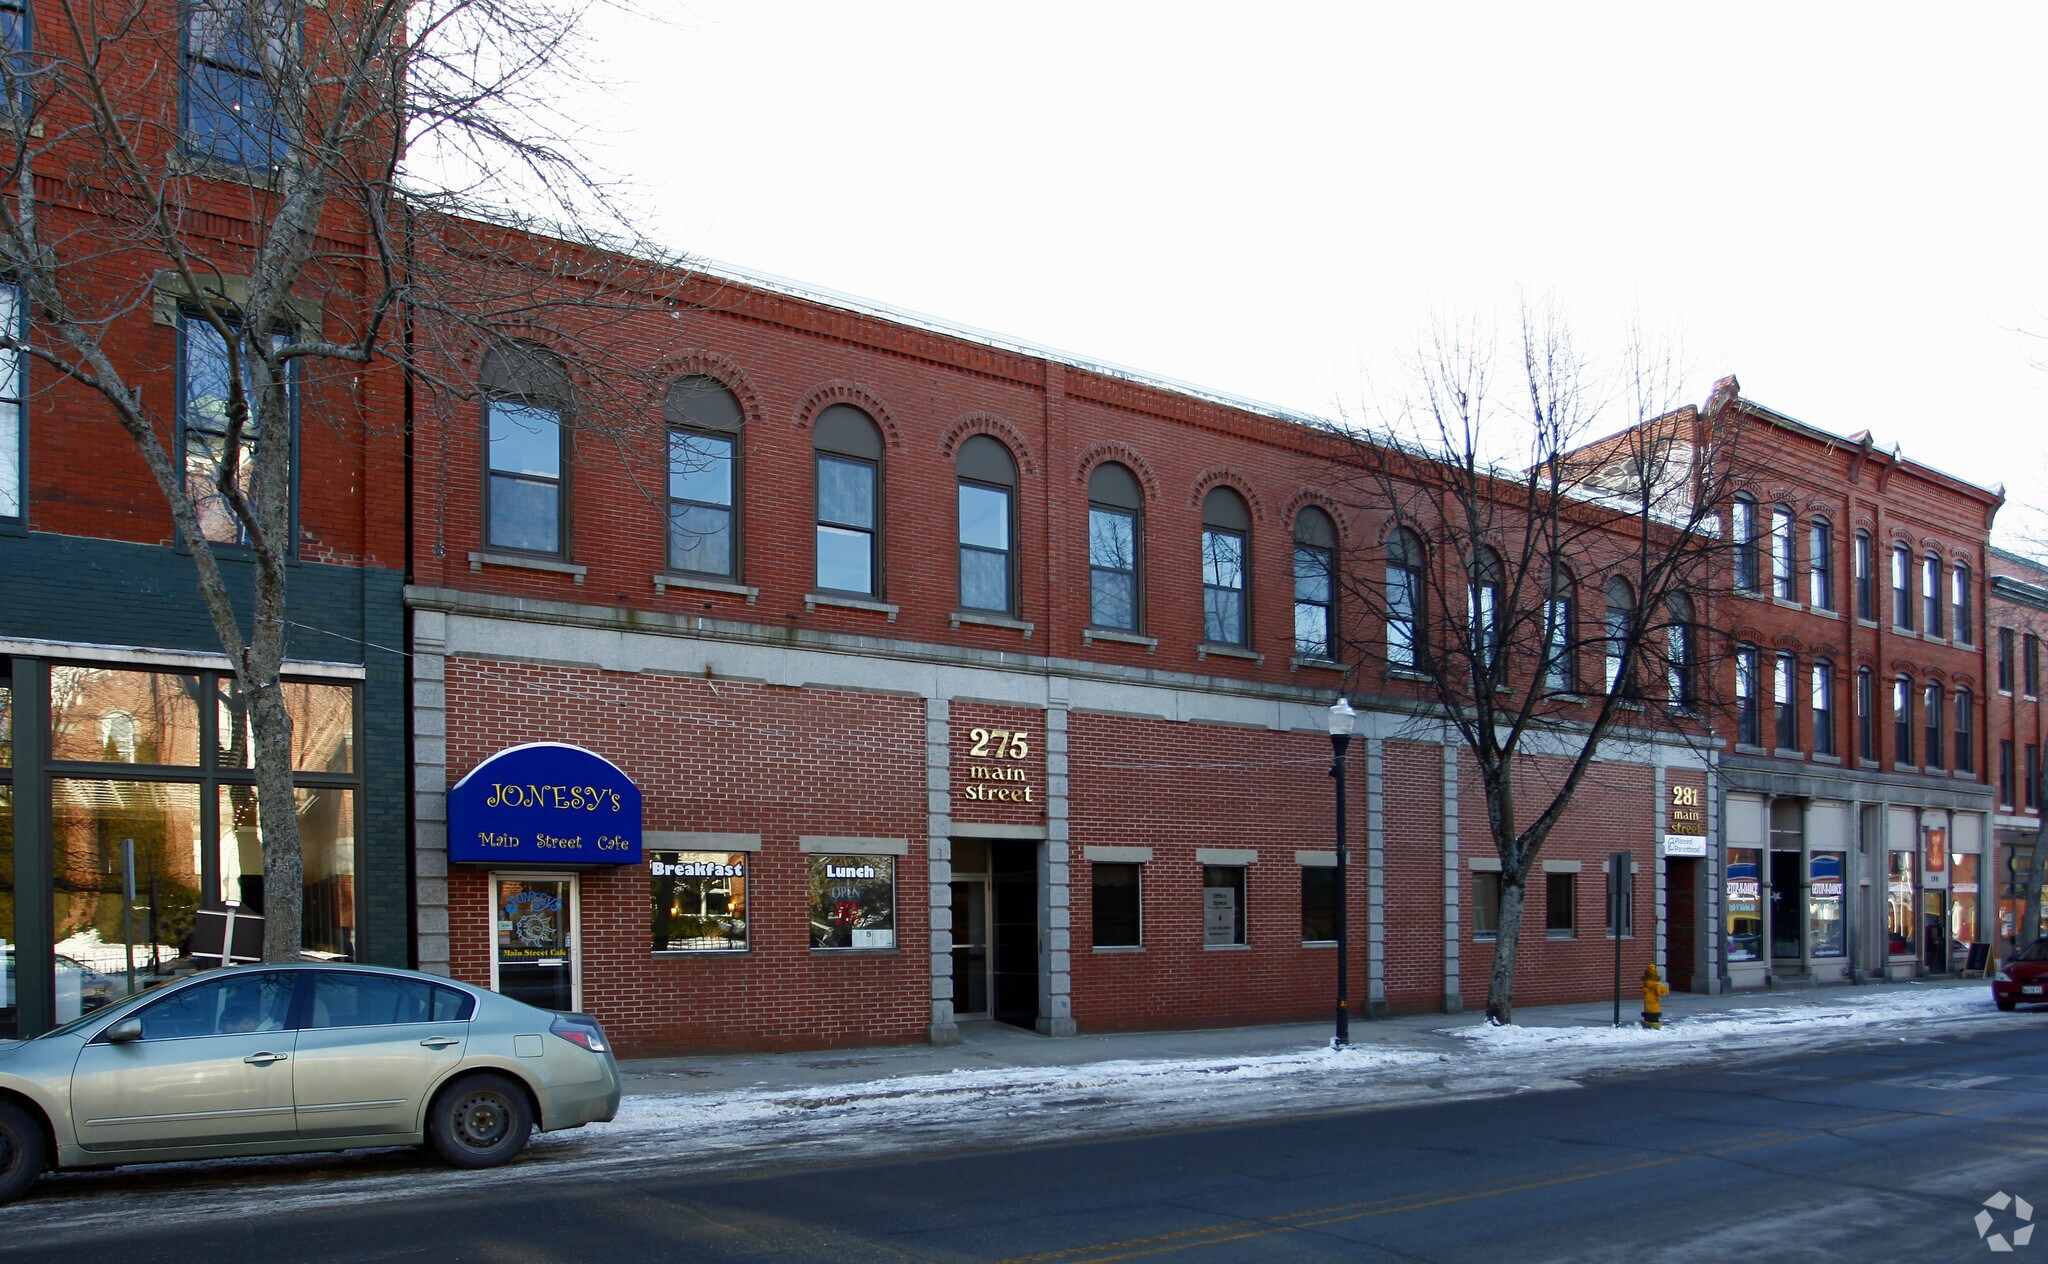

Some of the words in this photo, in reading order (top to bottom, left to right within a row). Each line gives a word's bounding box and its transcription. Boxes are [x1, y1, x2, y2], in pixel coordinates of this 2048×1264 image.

[969, 728, 1028, 760] 275
[970, 764, 1026, 781] main
[965, 783, 1034, 803] street
[1672, 785, 1698, 806] 281
[1673, 809, 1699, 820] main
[1671, 823, 1701, 834] street
[478, 832, 520, 848] Main
[536, 833, 583, 849] Street
[597, 835, 629, 851] Cafe
[1674, 837, 1693, 845] Planned
[651, 861, 743, 877] Breakfast
[826, 864, 875, 879] Lunch
[832, 886, 862, 899] OPEN
[503, 949, 523, 957] Main
[524, 948, 548, 957] Street
[550, 948, 567, 957] Cafe
